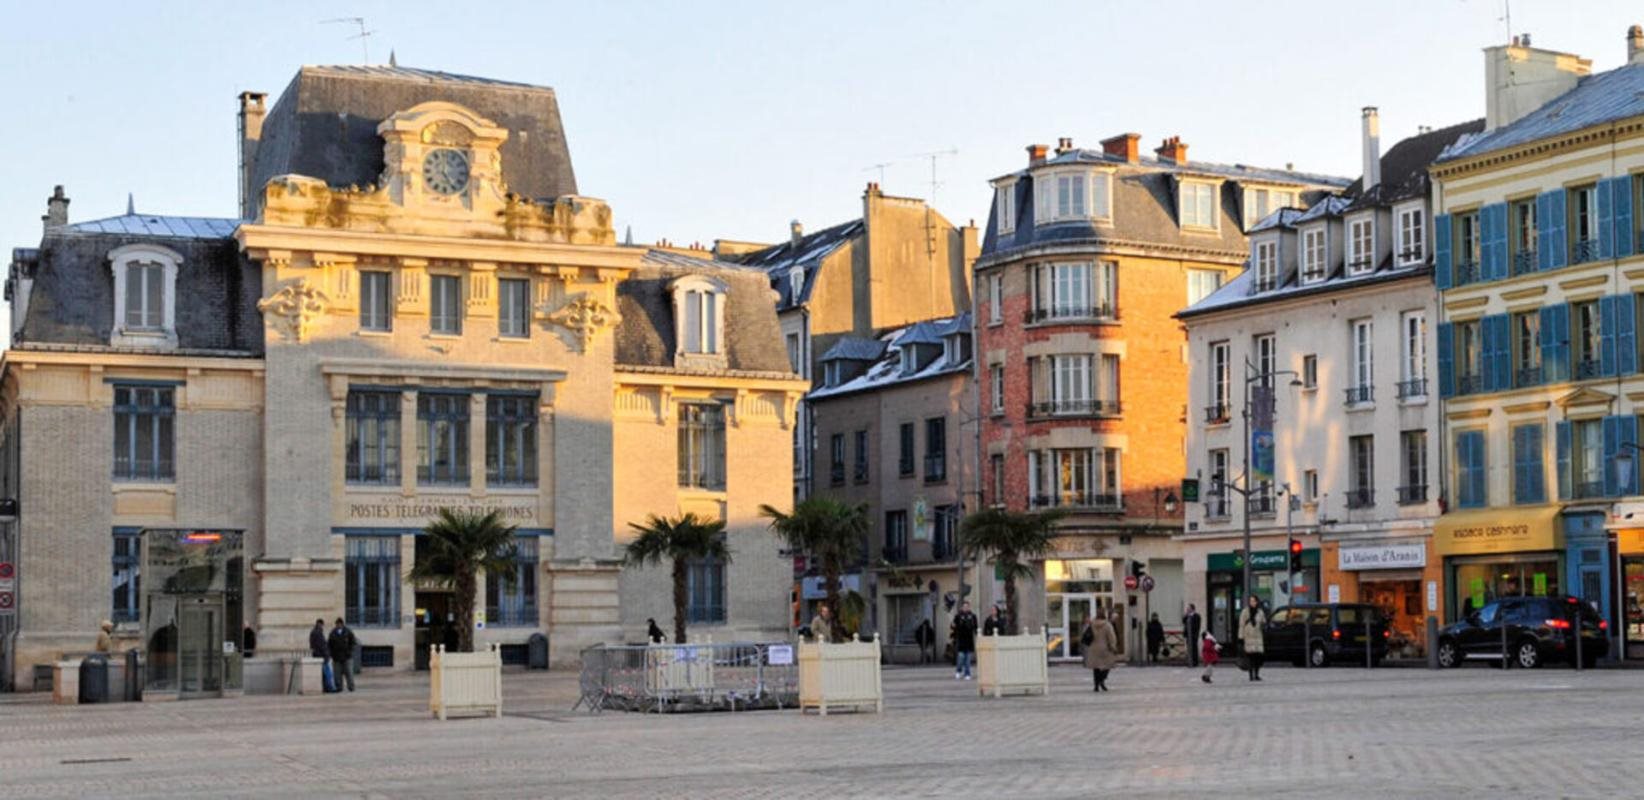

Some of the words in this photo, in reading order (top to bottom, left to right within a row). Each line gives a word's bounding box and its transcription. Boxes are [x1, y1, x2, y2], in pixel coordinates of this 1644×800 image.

[350, 503, 391, 518] POSTES
[395, 504, 464, 519] TELEGRAHES
[1343, 554, 1352, 564] La
[1353, 552, 1379, 563] Maison
